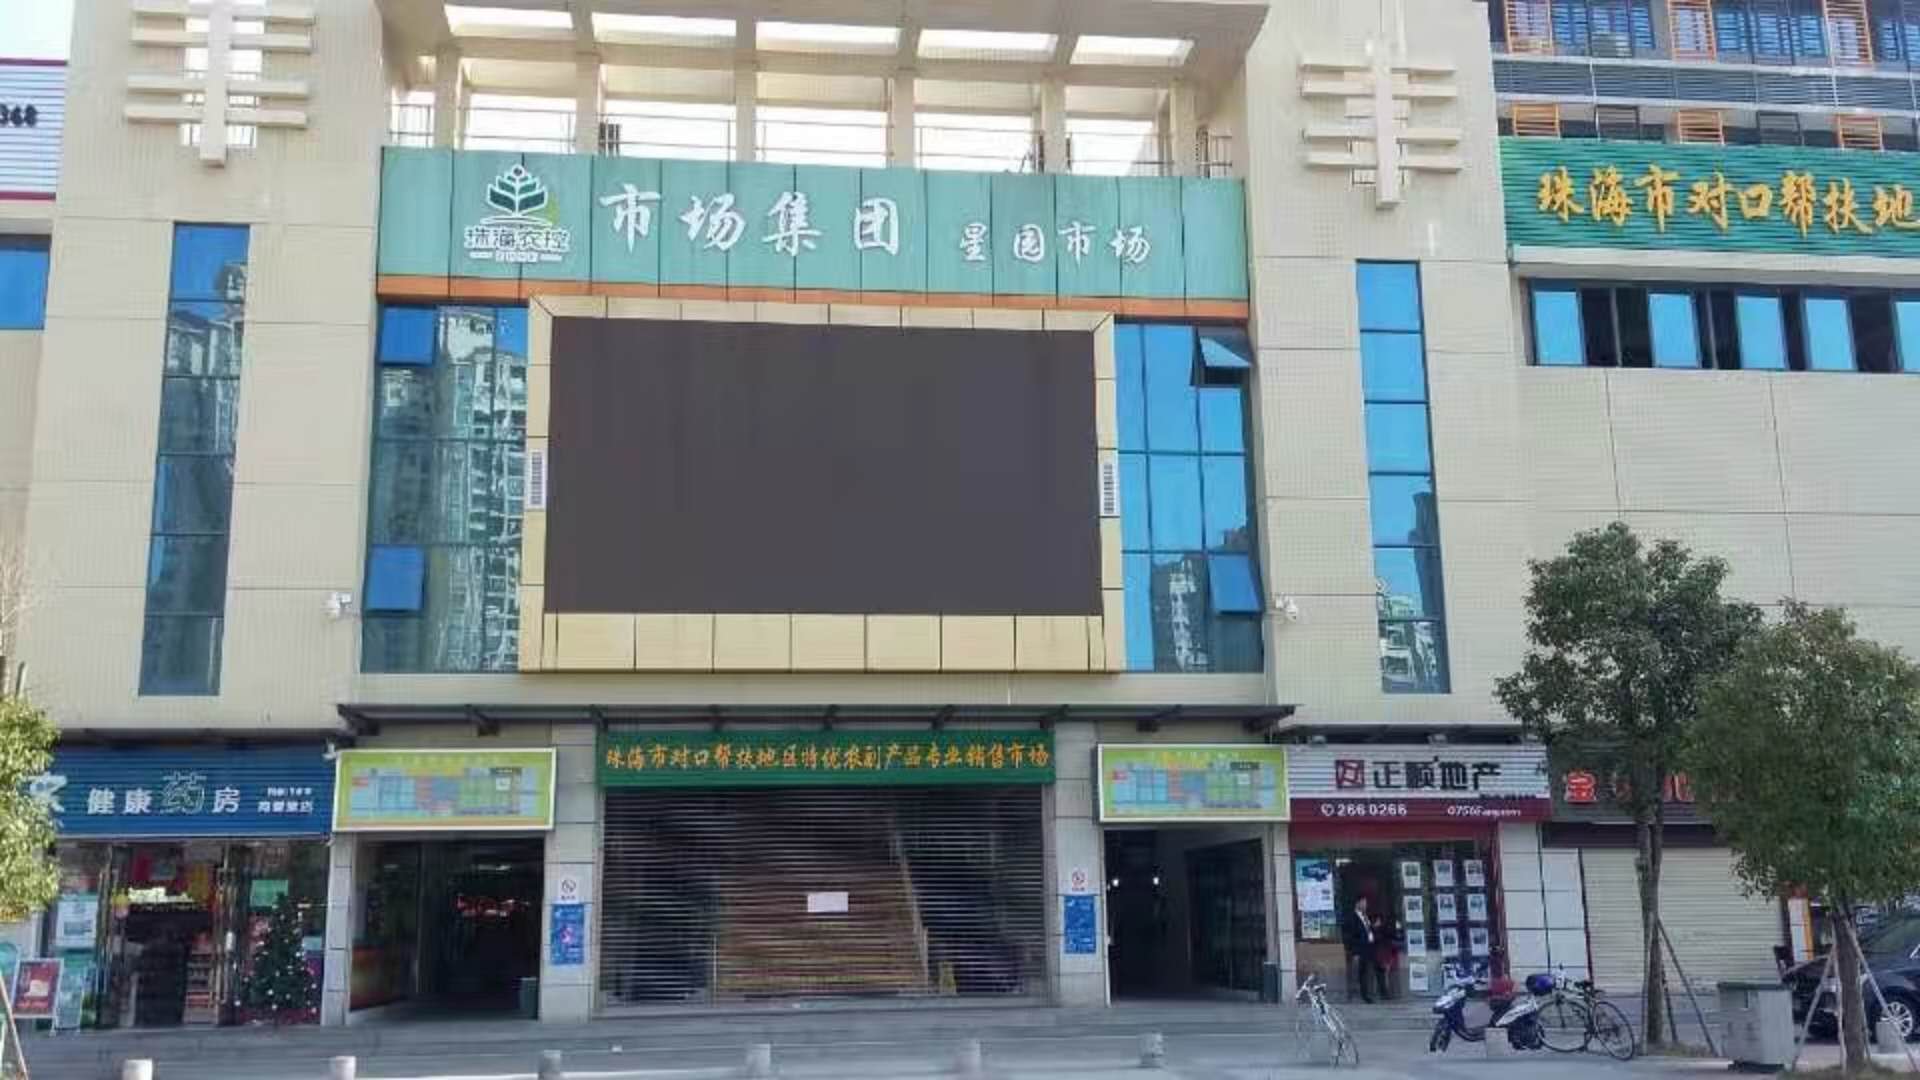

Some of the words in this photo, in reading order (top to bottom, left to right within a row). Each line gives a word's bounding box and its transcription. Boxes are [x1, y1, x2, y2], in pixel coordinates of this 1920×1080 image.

[600, 183, 899, 255] 市场集团
[959, 221, 1150, 266] 星园市场
[1537, 164, 1920, 237] 珠海市对口帮扶地
[464, 225, 570, 253] 珠海农控
[87, 770, 241, 815] 健康药房
